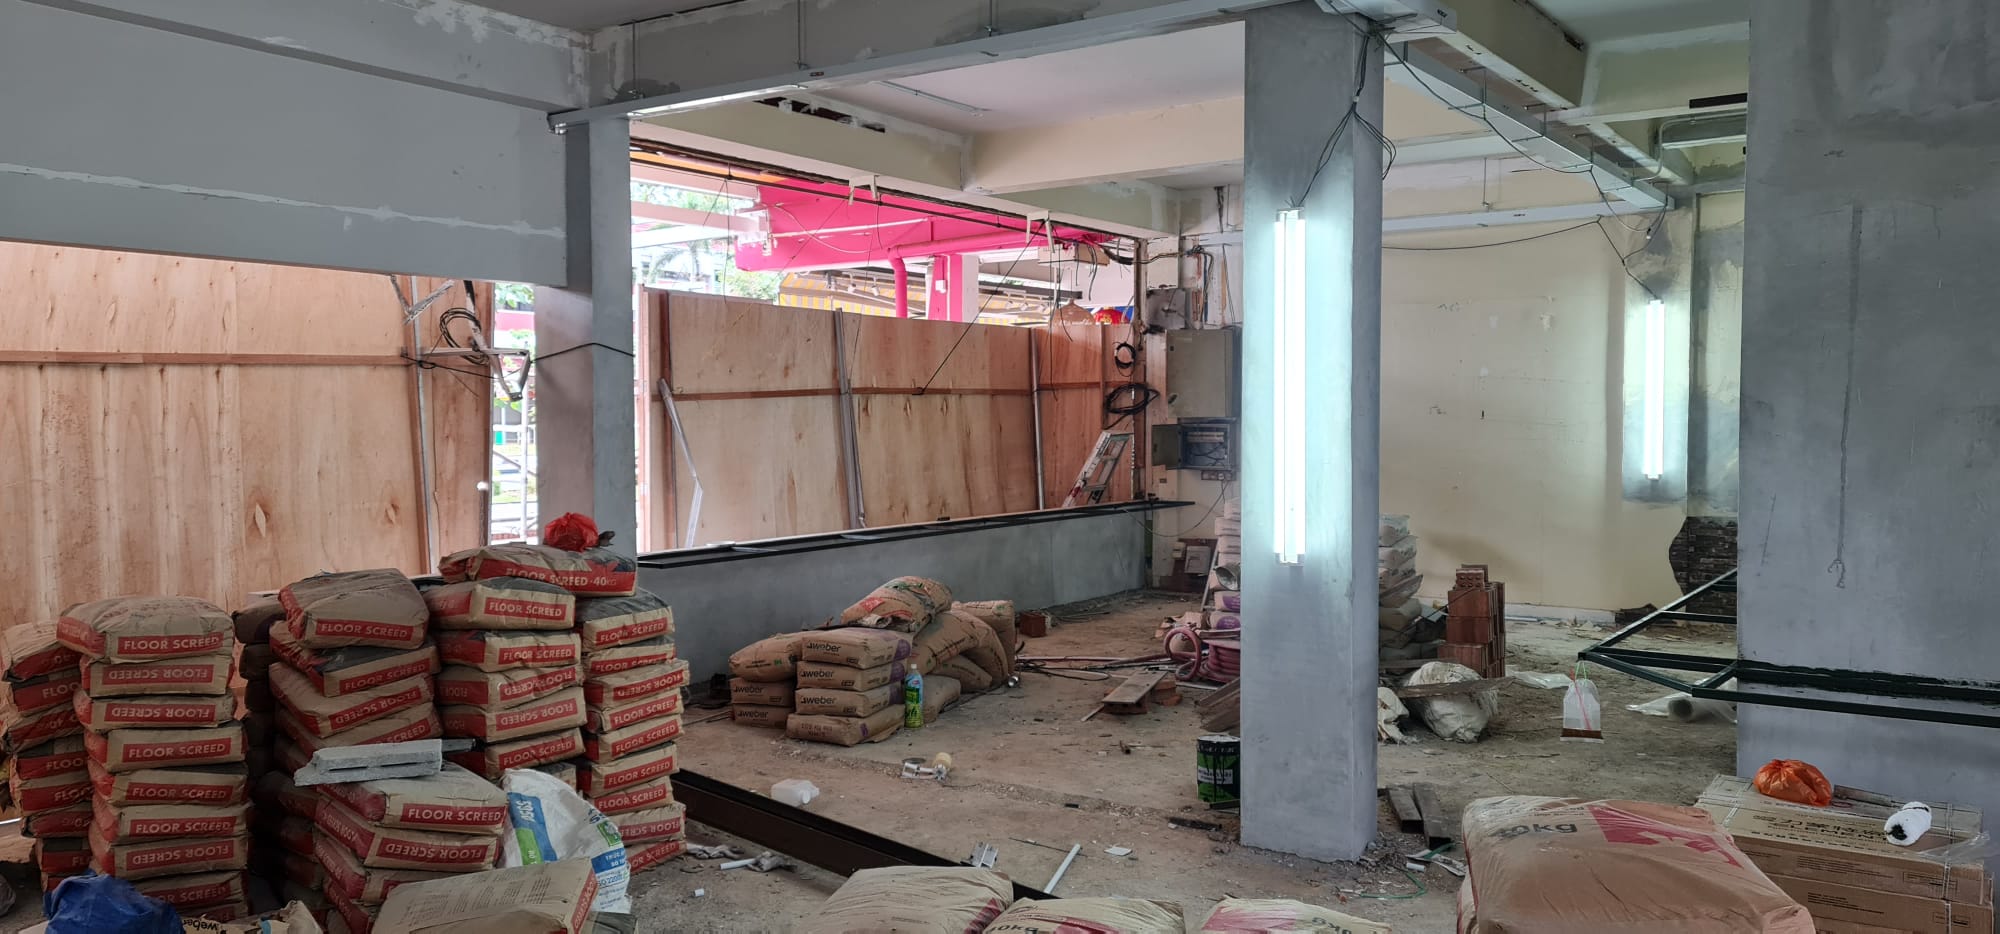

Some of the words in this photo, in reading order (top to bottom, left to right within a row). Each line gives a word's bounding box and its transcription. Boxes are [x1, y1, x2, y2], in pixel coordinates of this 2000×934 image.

[489, 602, 523, 614] FLOOR
[526, 604, 562, 617] SCREED
[320, 623, 362, 634] FLOOR
[366, 626, 408, 638] SCREED
[631, 621, 664, 636] SCREED
[123, 638, 169, 651] FLOOR
[172, 635, 220, 649] SCREED
[811, 642, 841, 653] weber
[503, 650, 534, 661] FLOOR
[535, 648, 572, 659] SCREED
[108, 668, 159, 680] SCREED
[162, 668, 208, 679] FLOOR
[344, 674, 384, 691] FLOOR
[386, 663, 427, 680] SCREED
[654, 673, 681, 688] FLOOR
[806, 669, 834, 678] weber
[380, 690, 417, 709] FLOOR
[804, 695, 837, 705] weber
[111, 706, 161, 718] SCREED
[165, 706, 211, 718] FLOOR
[335, 706, 377, 724] SCREED
[541, 702, 574, 718] FLOOR
[614, 709, 644, 726] FLOOR
[646, 700, 676, 714] SCREED
[500, 711, 538, 726] SCREED
[615, 736, 644, 753] FLOOR
[647, 724, 676, 741] SCREED
[129, 747, 174, 759] FLOOR
[180, 743, 226, 756] SCREED
[46, 756, 84, 770] FLOO
[607, 770, 638, 786] FLOOR
[641, 761, 671, 777] SCREED
[132, 786, 177, 798] FLOOR
[181, 788, 227, 799] SCREED
[598, 796, 631, 810] FLOOR
[632, 789, 665, 804] SCREED
[407, 807, 453, 821] FLOOR
[457, 810, 501, 823] SCREED
[135, 822, 181, 834] FLOOR
[184, 820, 231, 832] SCREED
[650, 821, 680, 834] FLOOR
[132, 850, 181, 865] SCREED
[185, 844, 229, 858] FLOOR
[386, 843, 436, 858] SCREED
[439, 848, 482, 861] FLOOR
